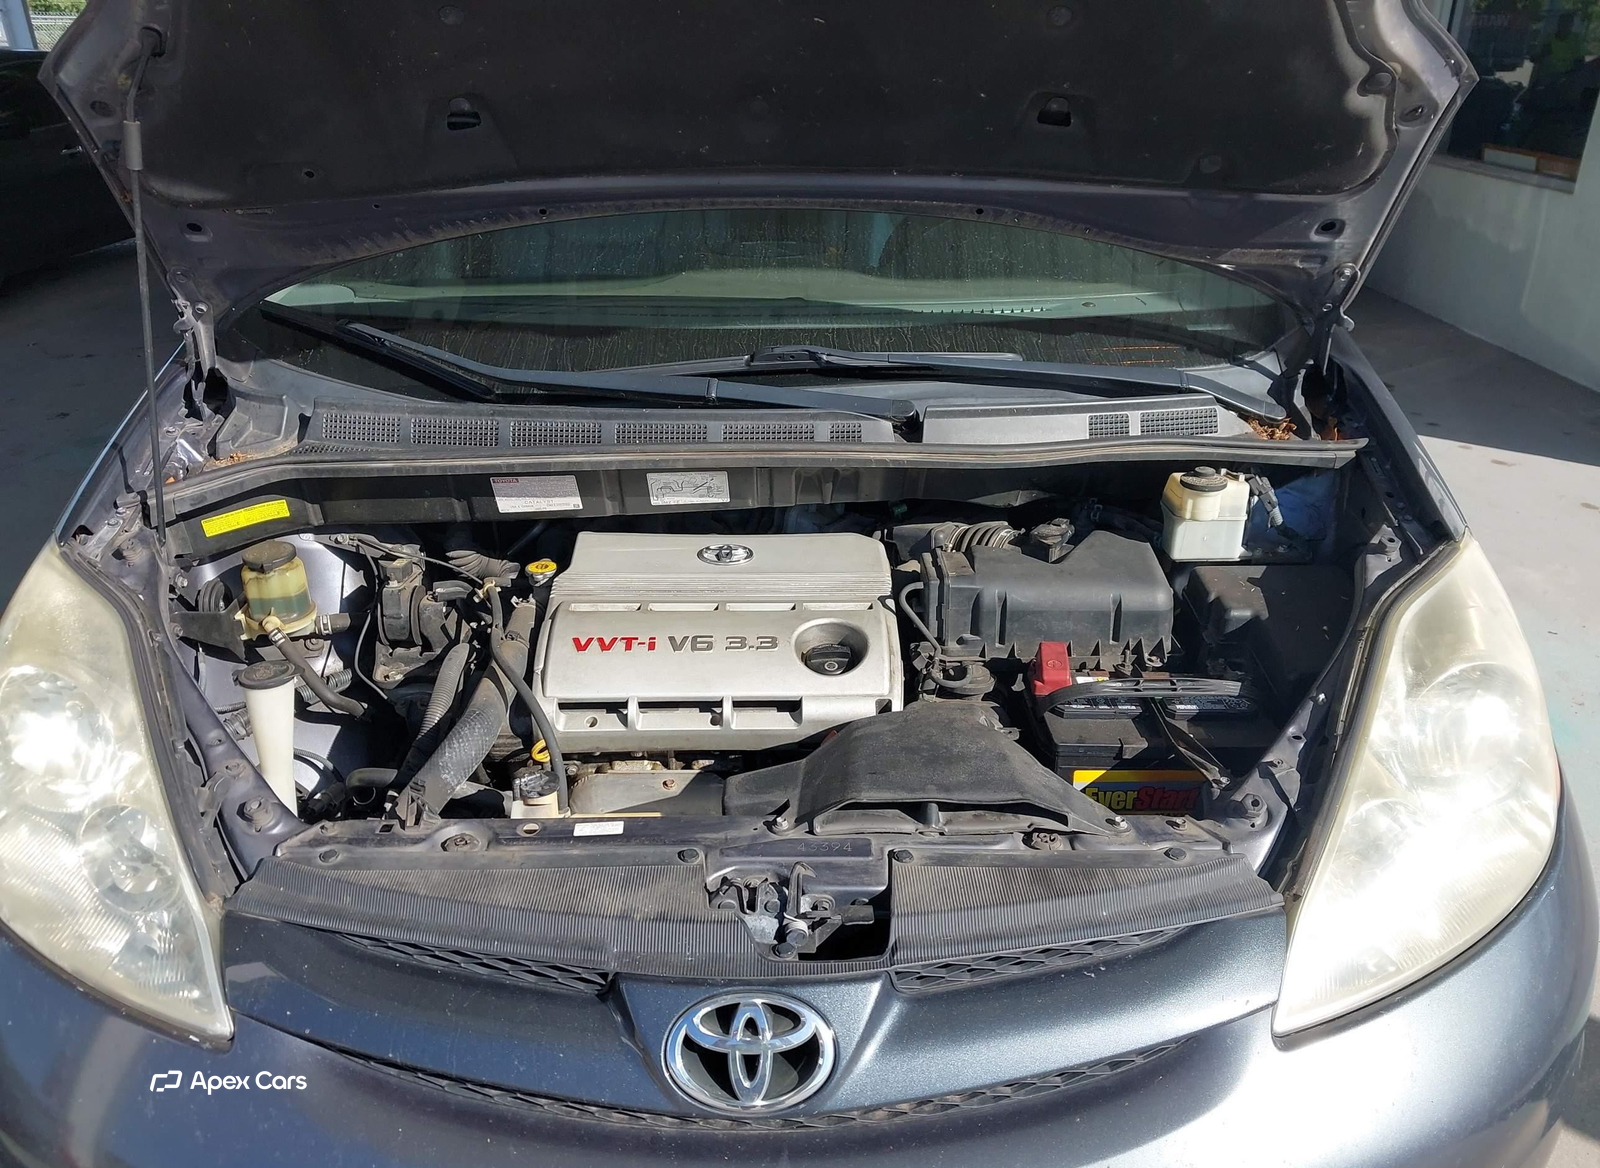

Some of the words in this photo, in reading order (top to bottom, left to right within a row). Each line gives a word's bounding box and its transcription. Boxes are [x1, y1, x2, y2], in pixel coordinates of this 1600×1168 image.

[572, 636, 657, 652] VVT-i
[667, 635, 714, 653] V6
[725, 635, 780, 652] 3.3
